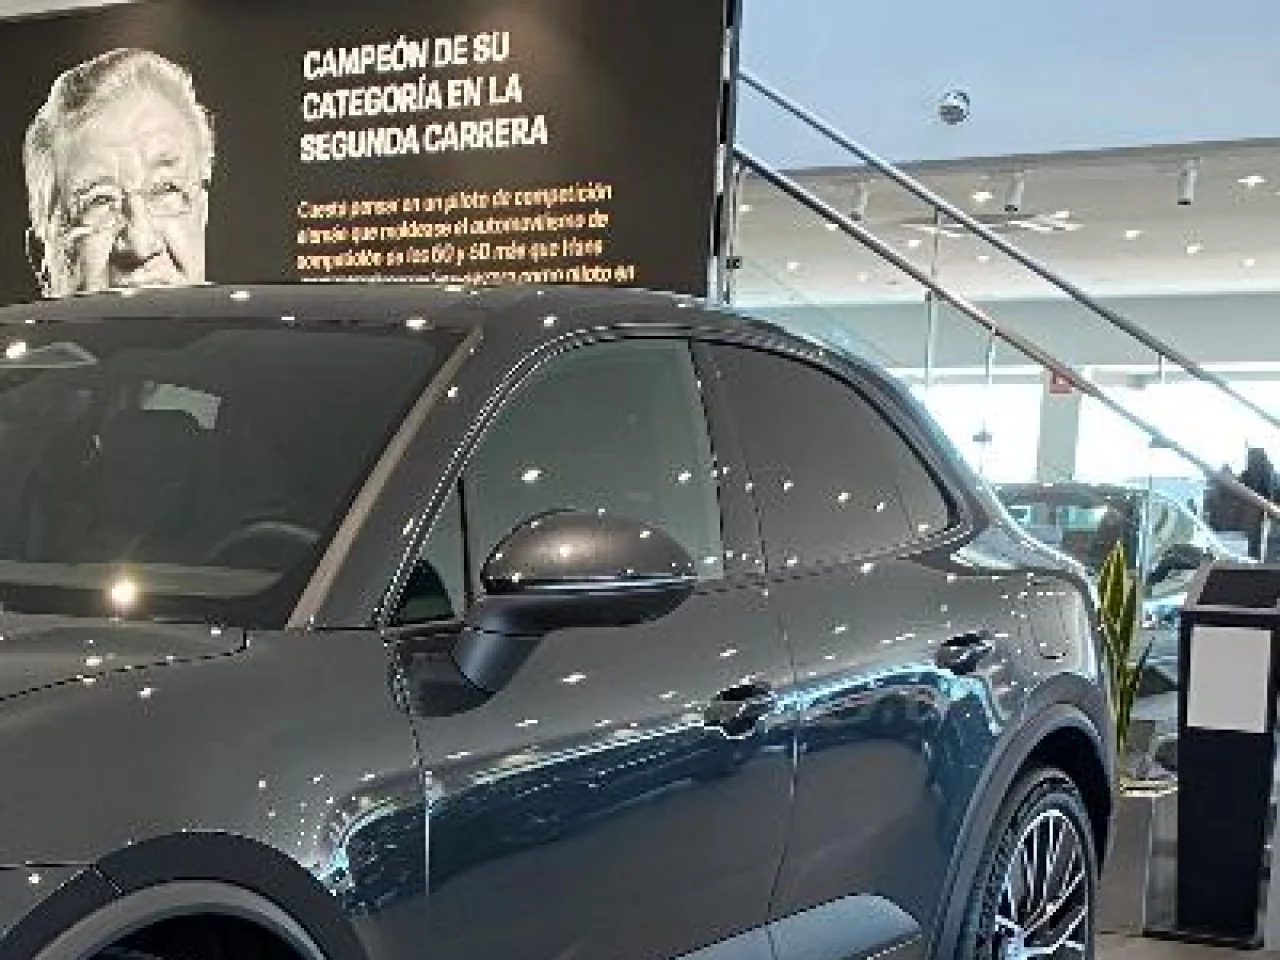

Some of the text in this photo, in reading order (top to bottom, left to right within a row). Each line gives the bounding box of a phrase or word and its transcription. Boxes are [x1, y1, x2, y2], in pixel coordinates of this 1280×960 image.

[303, 31, 510, 79] CAMPEÓN DE SU
[302, 73, 523, 122] CATEGORÍA EN LA
[300, 115, 548, 161] SEGUNDA CARRERA
